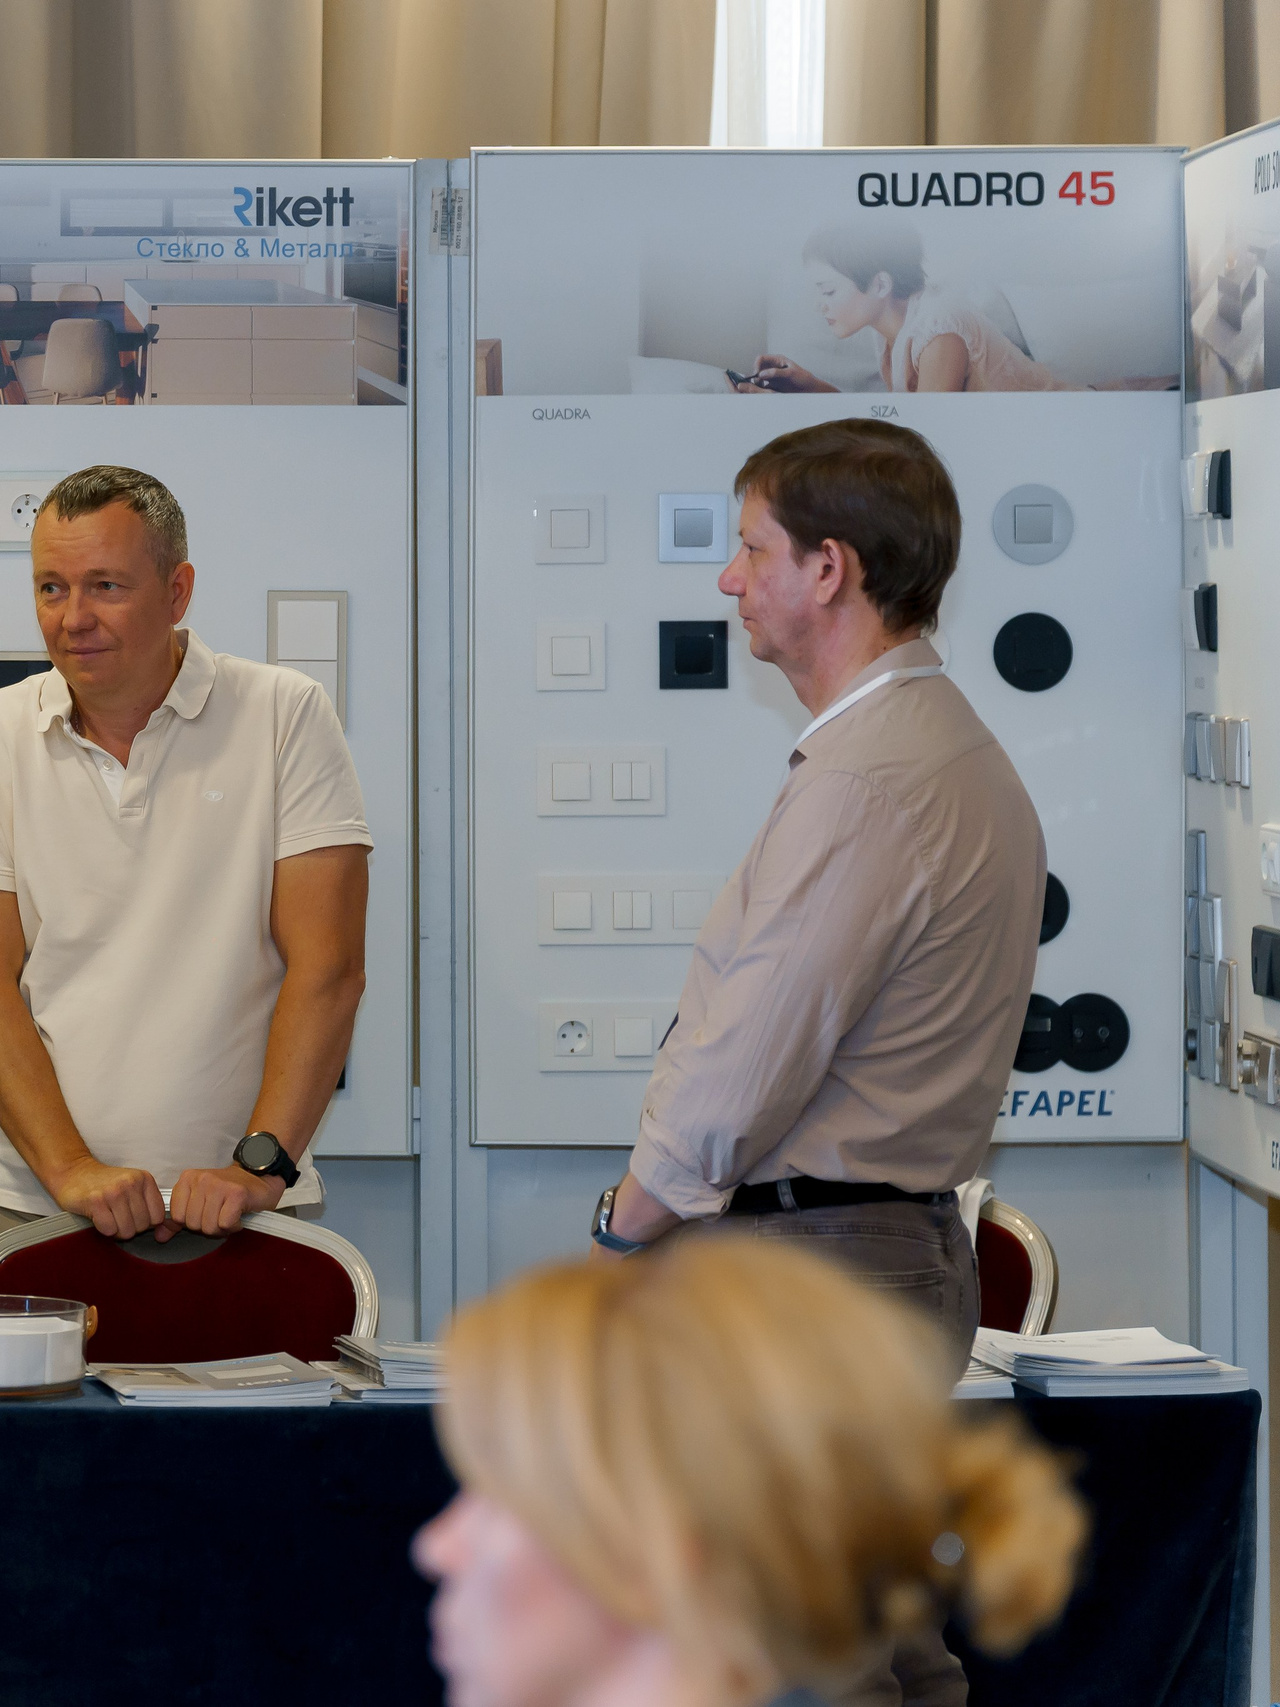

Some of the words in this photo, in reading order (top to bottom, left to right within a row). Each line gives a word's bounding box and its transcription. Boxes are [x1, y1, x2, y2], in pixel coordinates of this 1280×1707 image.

[858, 172, 1045, 207] QUADRO
[1058, 171, 1115, 206] 45
[234, 187, 354, 227] Rikett
[137, 237, 225, 258] Стекло
[234, 237, 250, 258] &
[261, 237, 354, 258] Металл
[532, 408, 591, 421] QUADRA
[871, 405, 899, 418] SIZA
[1272, 1141, 1280, 1171] EF
